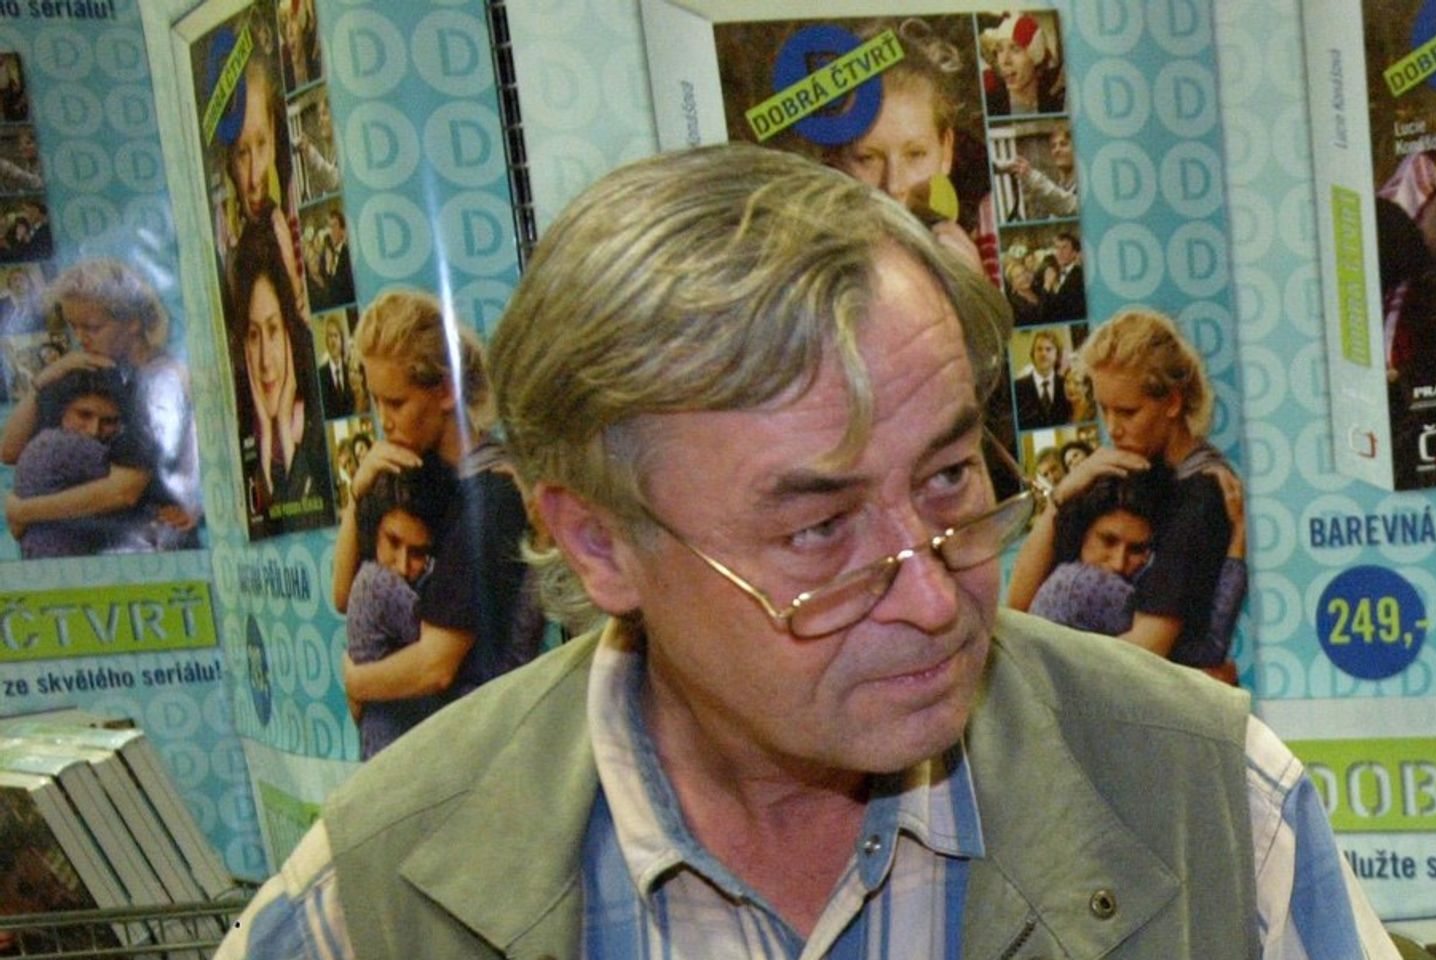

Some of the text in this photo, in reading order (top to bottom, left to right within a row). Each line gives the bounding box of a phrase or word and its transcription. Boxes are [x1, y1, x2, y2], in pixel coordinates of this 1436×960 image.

[751, 77, 829, 135] DOBRÁ
[830, 32, 898, 90] ČTVRŤ
[1309, 506, 1436, 548] BAREVNÁ
[0, 585, 203, 649] ČTVRŤ
[1328, 595, 1432, 648] 249,-
[3, 680, 29, 697] ze
[37, 667, 135, 695] skvělého
[142, 659, 222, 686] seriálu!
